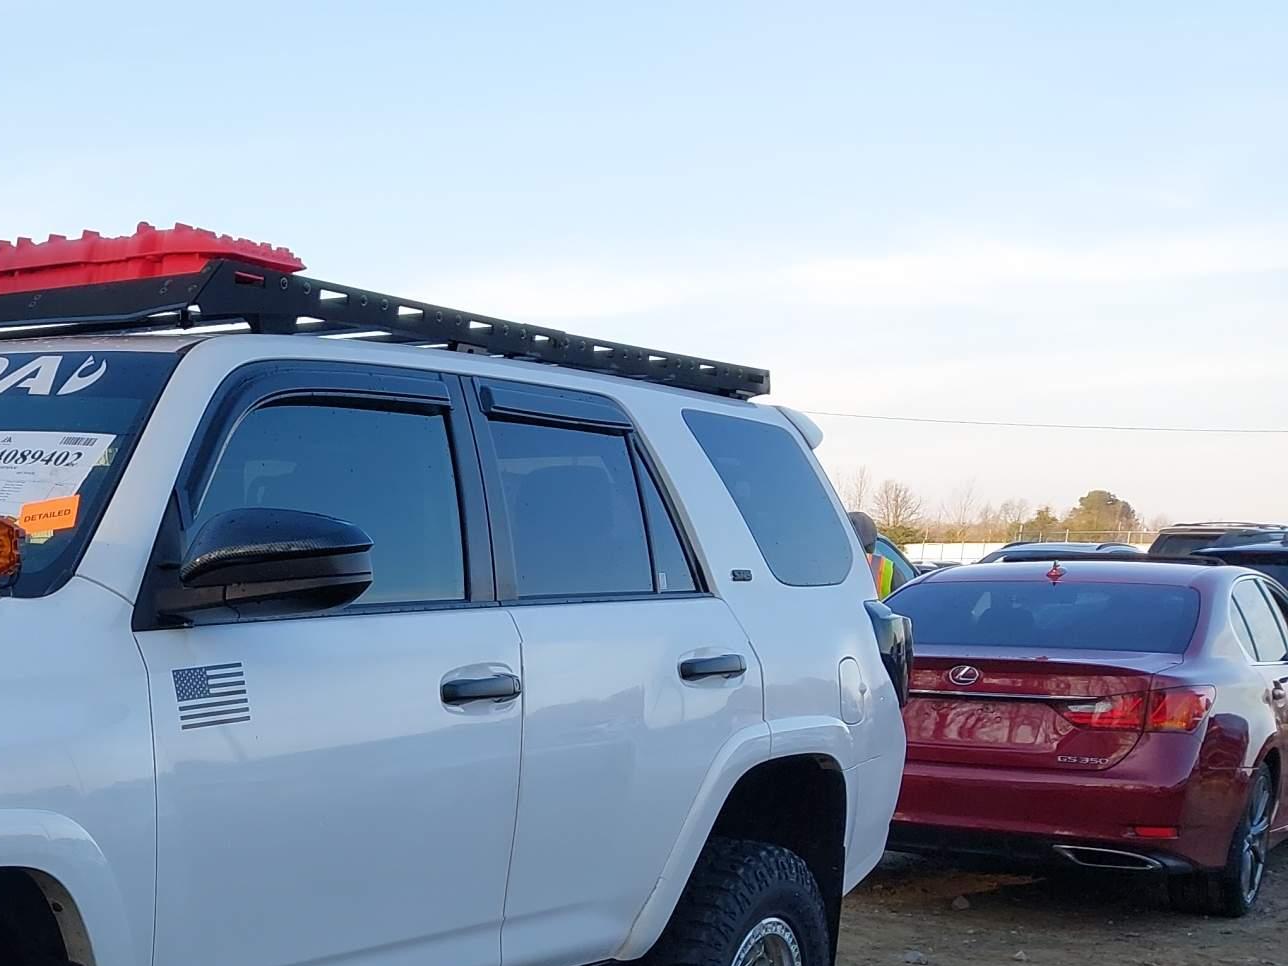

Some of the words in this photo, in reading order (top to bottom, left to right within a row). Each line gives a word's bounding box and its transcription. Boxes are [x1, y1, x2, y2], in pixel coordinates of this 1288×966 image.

[23, 508, 71, 523] DETAILED
[1057, 755, 1078, 763] GS
[1079, 756, 1110, 765] 350
